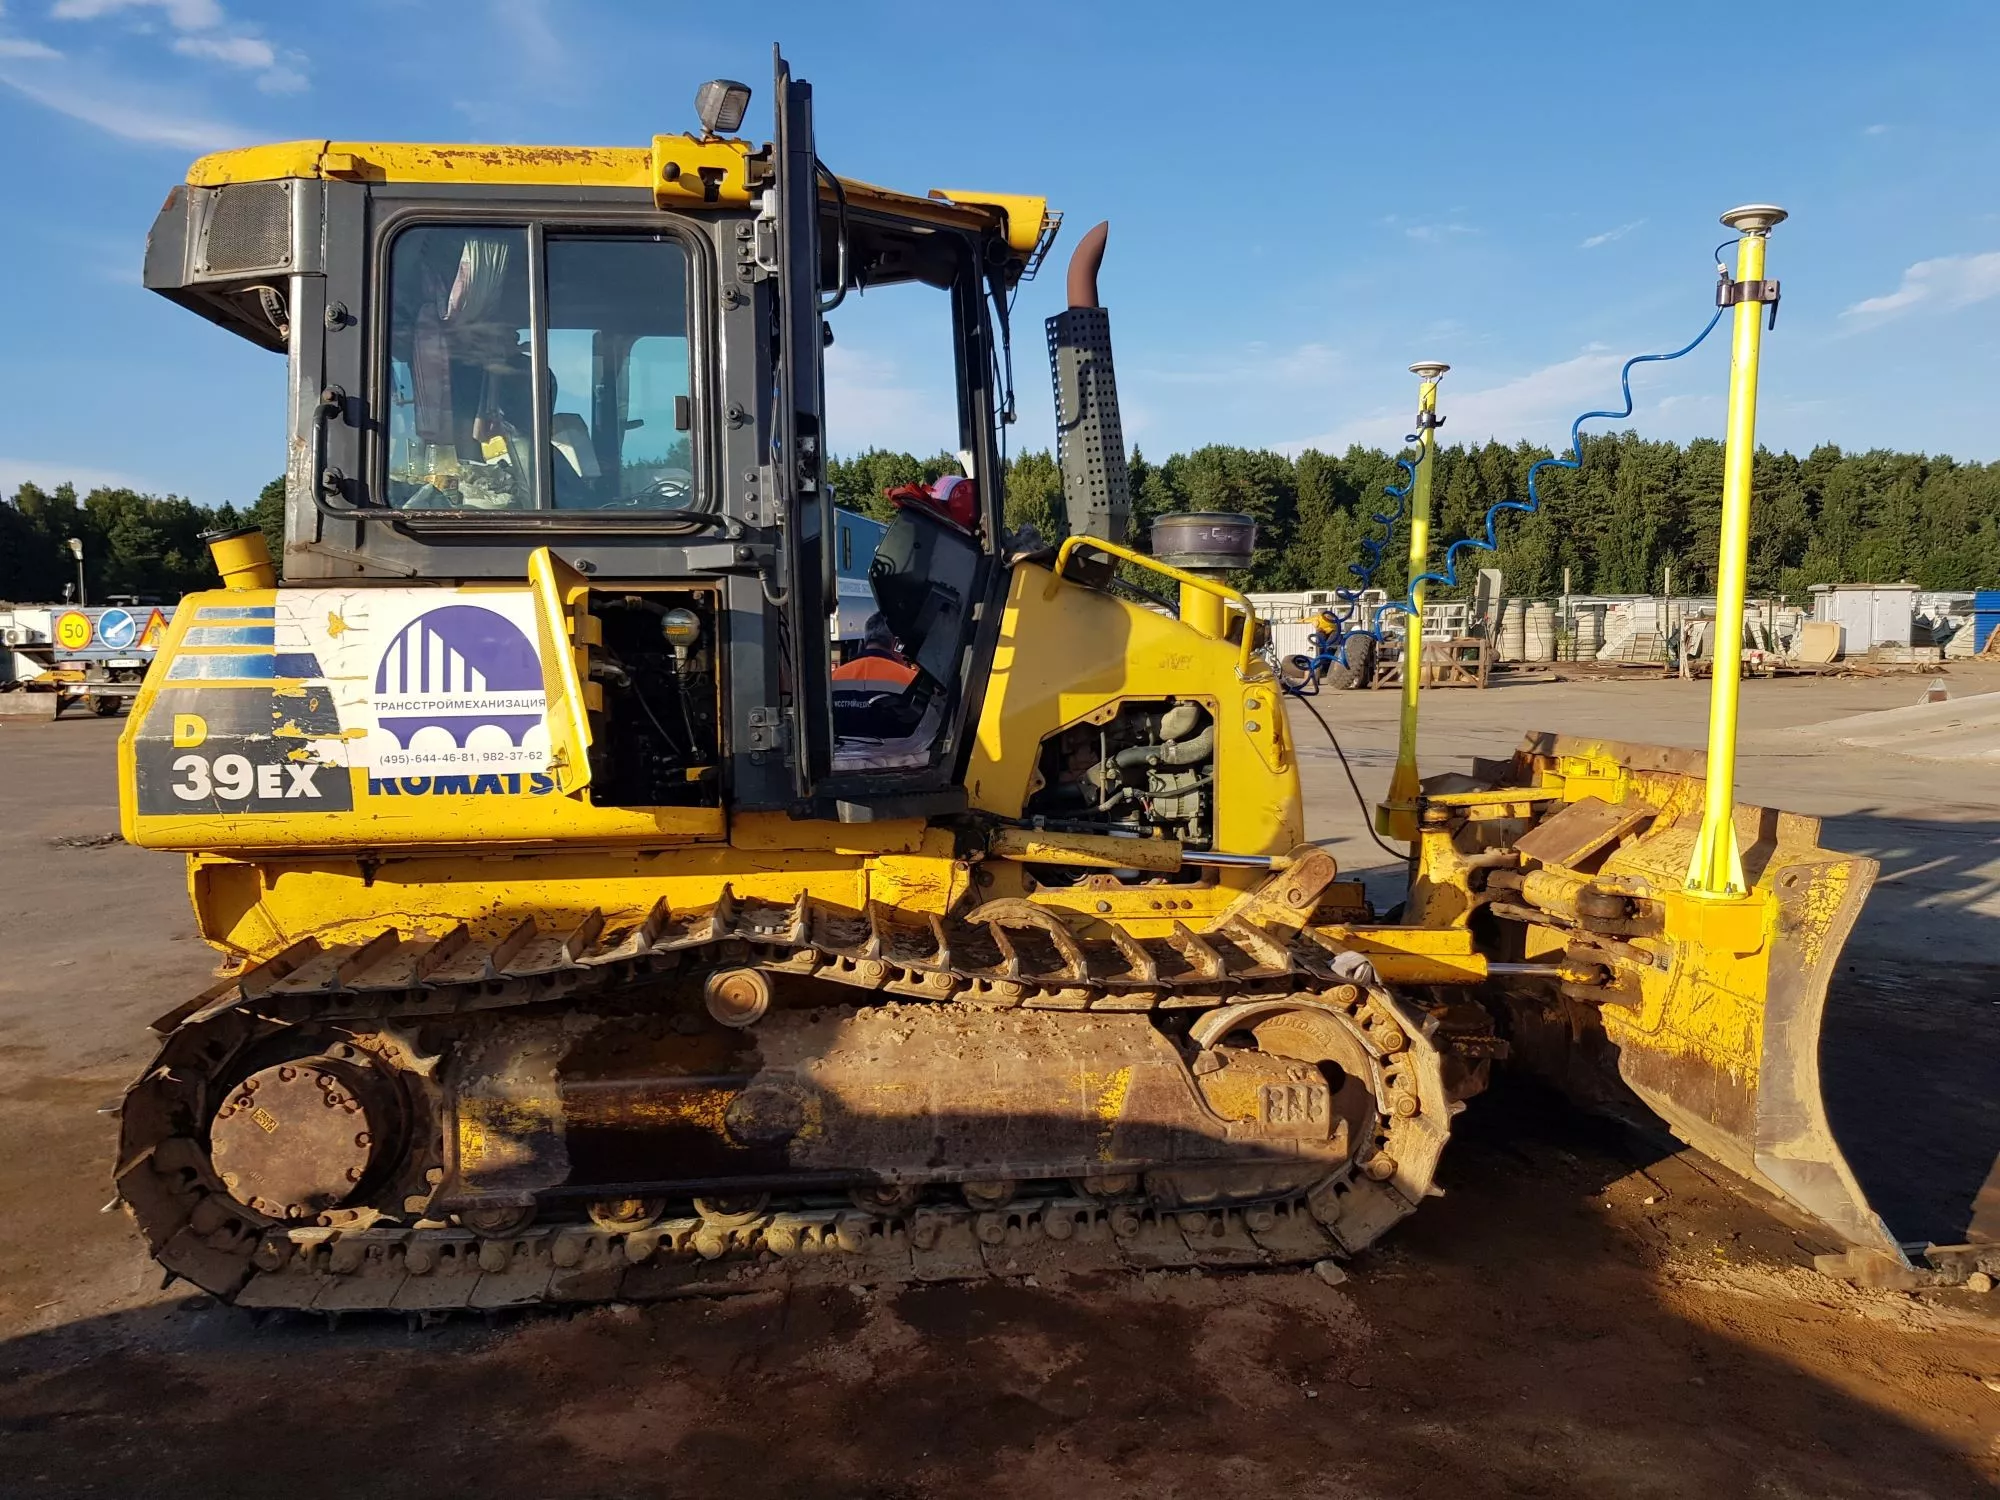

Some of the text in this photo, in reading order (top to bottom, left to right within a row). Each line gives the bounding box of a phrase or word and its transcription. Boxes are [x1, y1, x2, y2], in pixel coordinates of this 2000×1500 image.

[64, 623, 84, 639] 50
[374, 698, 546, 711] ТРАНССТРОЙМЕХАНИЗАЦИЯ
[173, 713, 207, 748] D
[482, 751, 543, 761] 982-37-62
